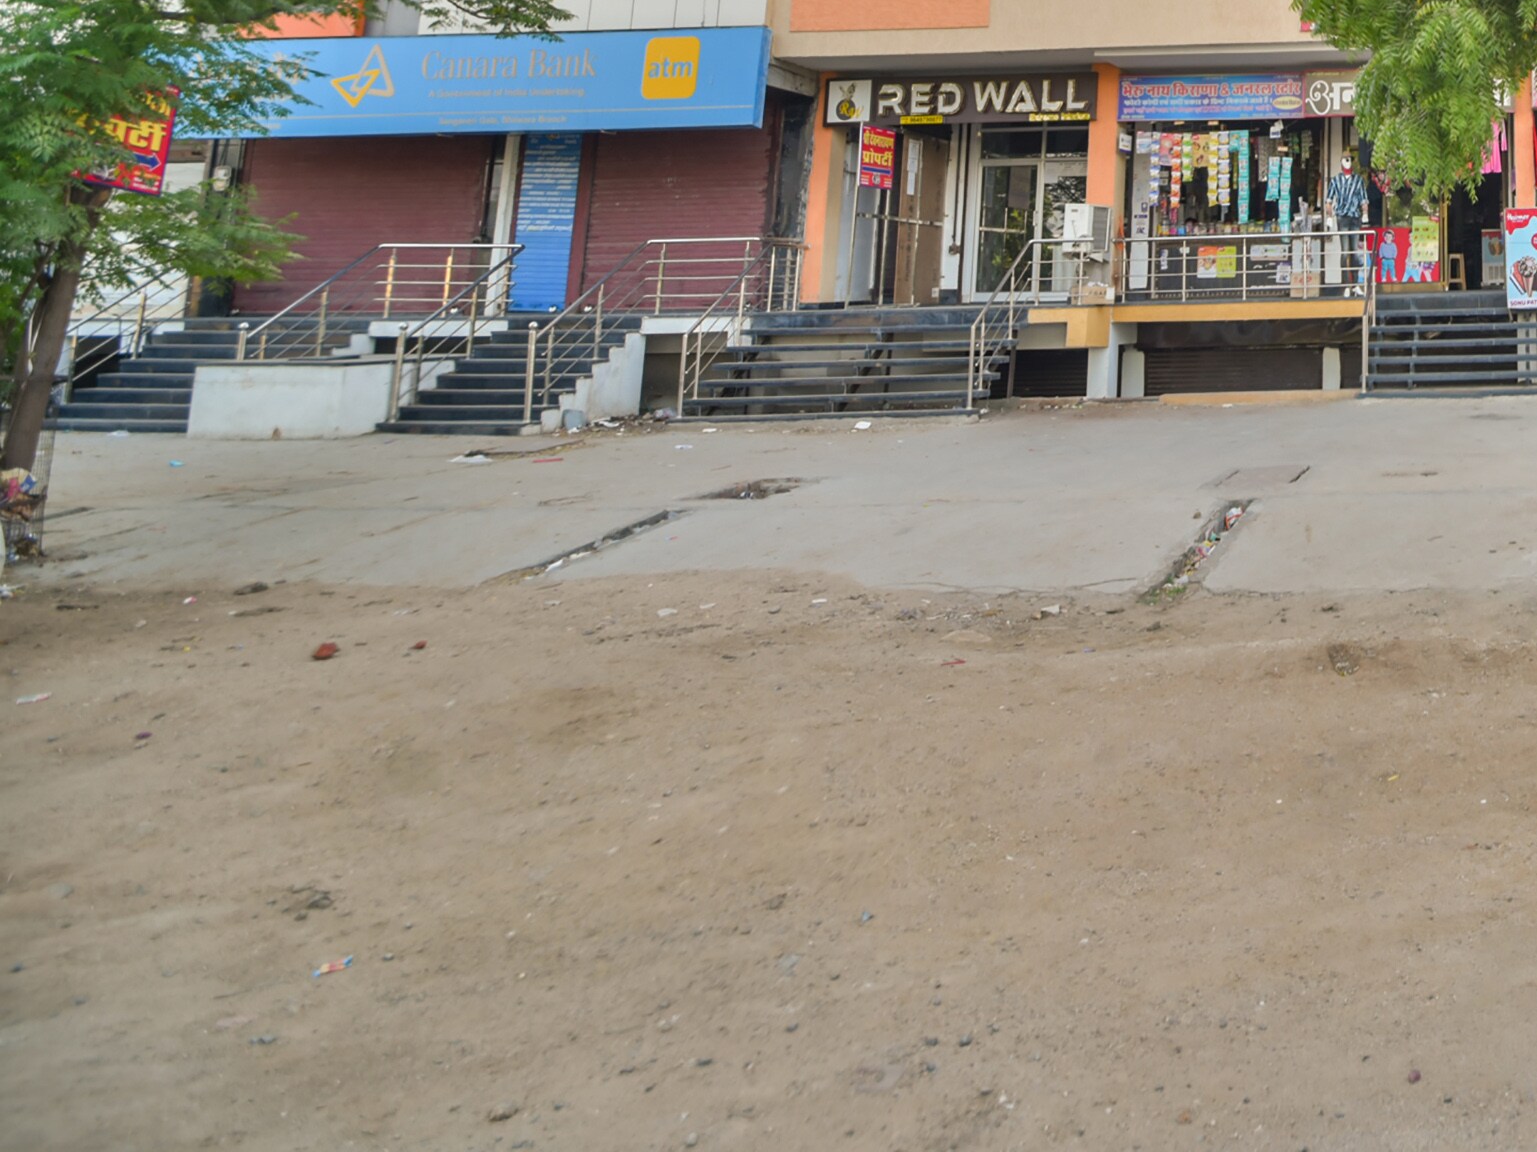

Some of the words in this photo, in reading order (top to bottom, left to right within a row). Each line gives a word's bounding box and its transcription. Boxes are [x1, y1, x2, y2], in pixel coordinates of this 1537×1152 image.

[421, 49, 518, 80] Canara
[528, 47, 598, 78] Bank
[649, 57, 693, 78] atm
[878, 82, 964, 117] RED
[973, 79, 1089, 114] WALL
[1220, 82, 1230, 96] &
